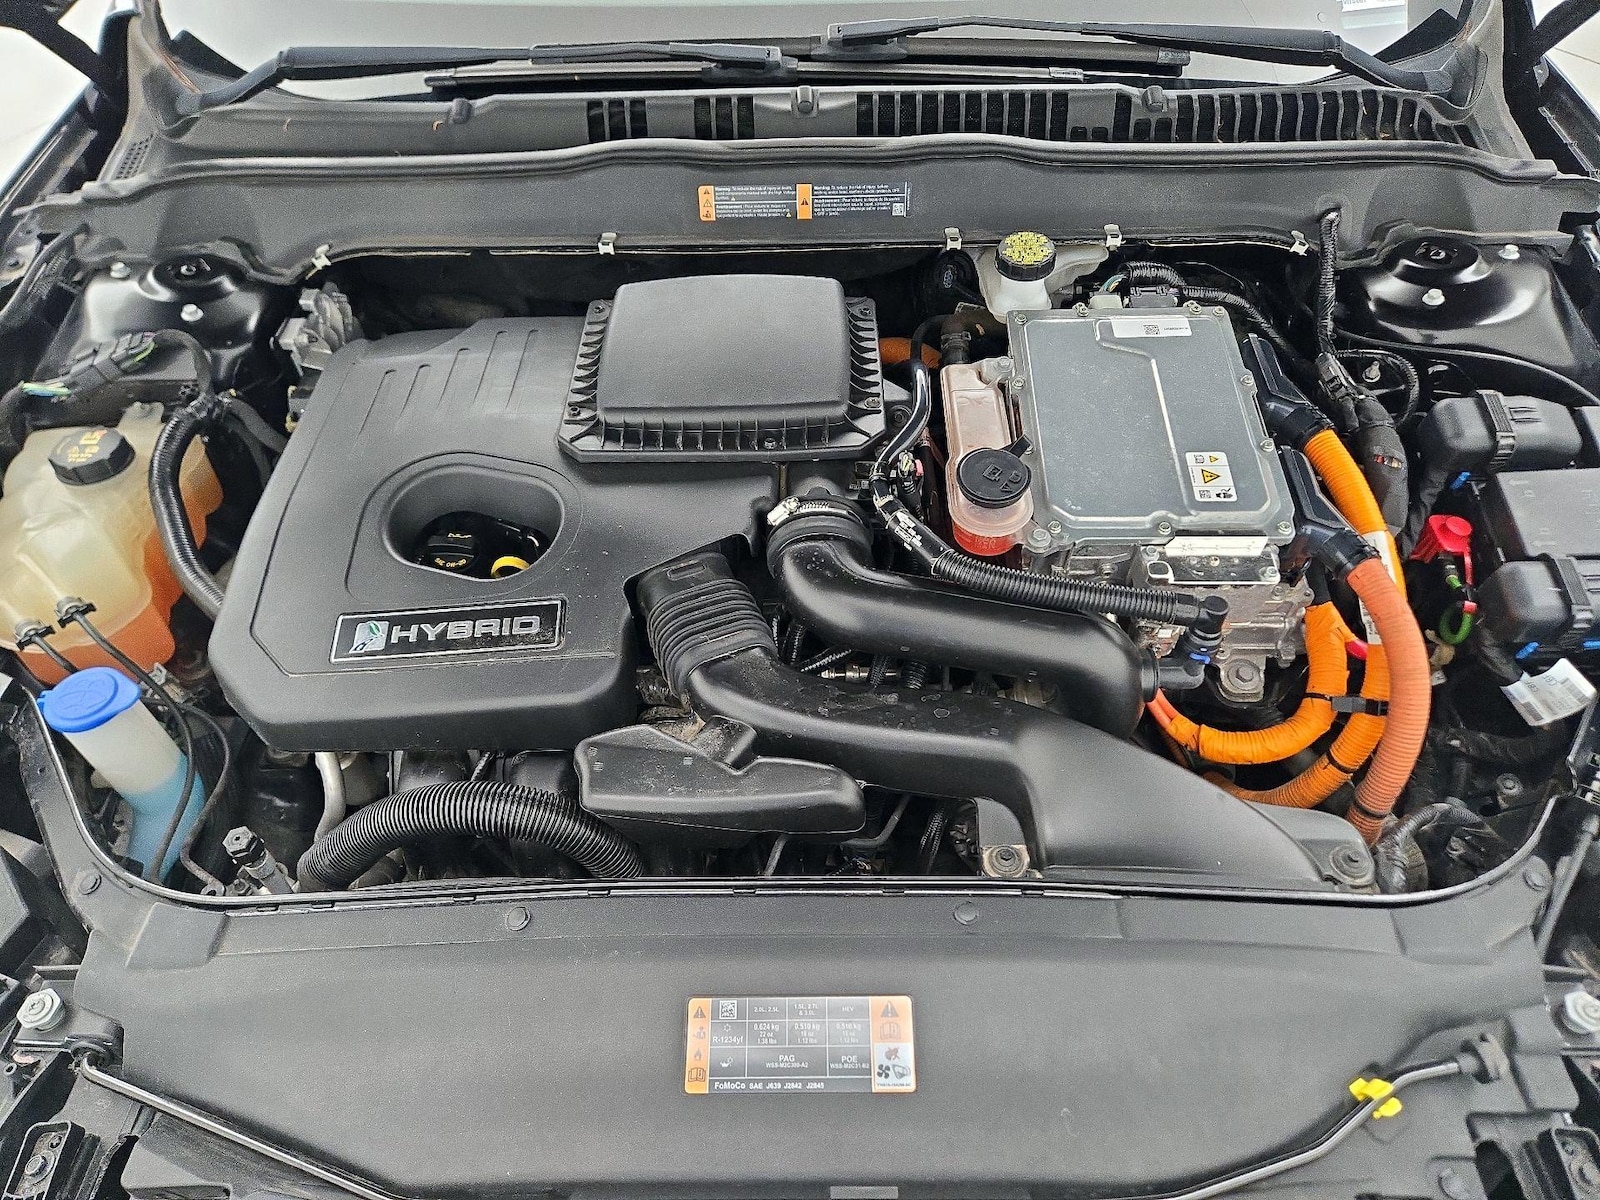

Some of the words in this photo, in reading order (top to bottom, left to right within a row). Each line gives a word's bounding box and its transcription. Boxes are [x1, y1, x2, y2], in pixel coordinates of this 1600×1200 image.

[390, 615, 541, 644] HYBRID
[753, 1023, 770, 1031] 0.624
[771, 1023, 780, 1032] kg
[794, 1023, 811, 1031] 0.510
[812, 1023, 820, 1031] kg
[712, 1036, 744, 1045] R-1234yf
[779, 1054, 795, 1062] PAG
[841, 1055, 858, 1063] POE
[714, 1081, 746, 1089] FoMoCo
[784, 1081, 802, 1089] J2842
